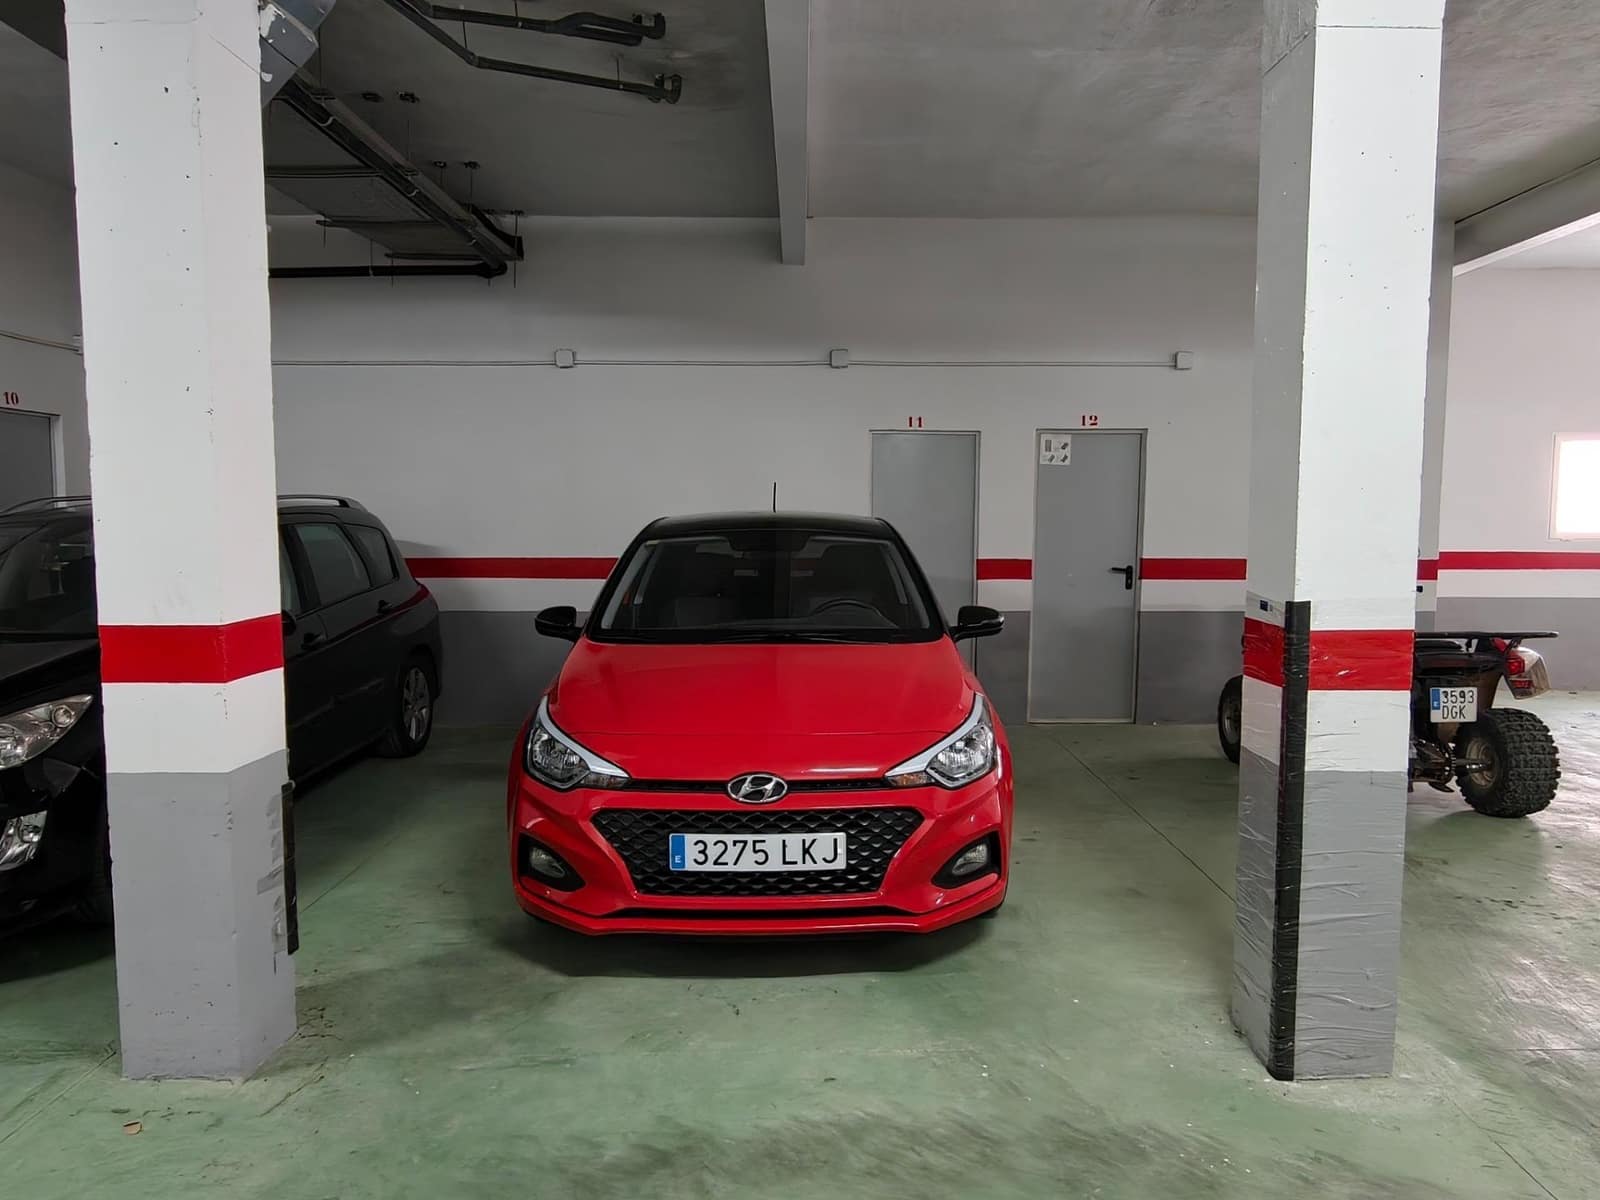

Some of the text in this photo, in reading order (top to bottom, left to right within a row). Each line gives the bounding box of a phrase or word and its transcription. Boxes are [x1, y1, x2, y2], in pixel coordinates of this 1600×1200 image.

[3, 391, 20, 405] 10
[907, 415, 923, 428] 11
[1081, 414, 1099, 427] 12
[1441, 689, 1475, 704] 3593
[1441, 705, 1467, 720] DGK
[692, 839, 770, 866] 3275
[781, 837, 839, 866] LKJ
